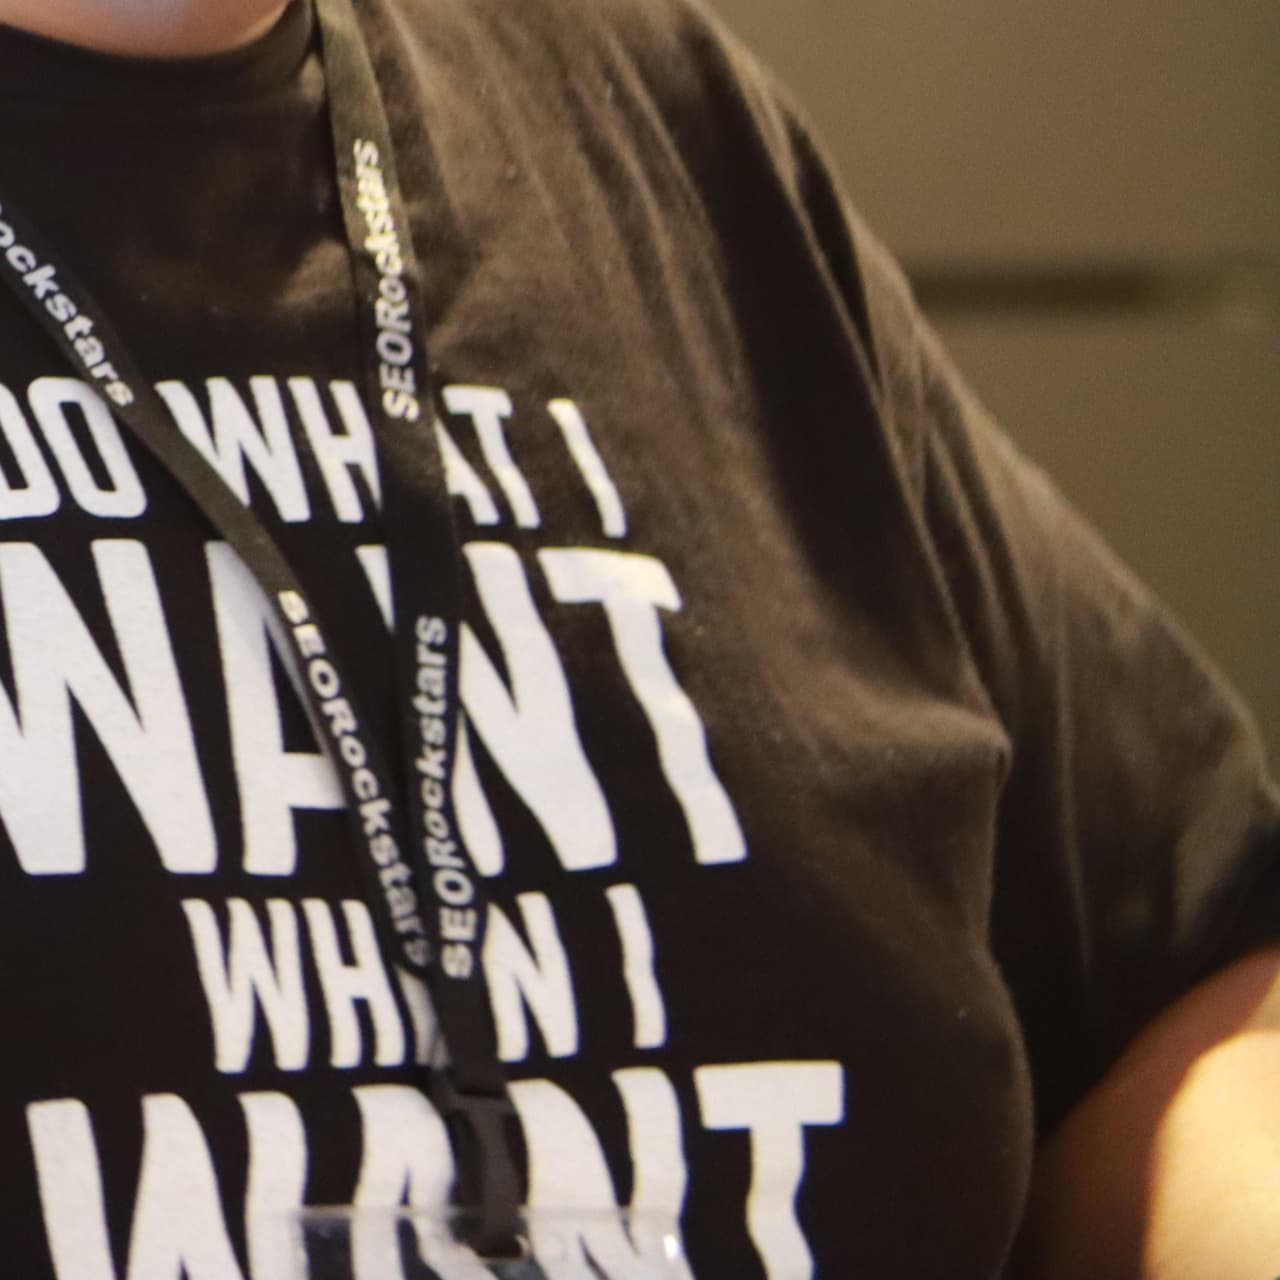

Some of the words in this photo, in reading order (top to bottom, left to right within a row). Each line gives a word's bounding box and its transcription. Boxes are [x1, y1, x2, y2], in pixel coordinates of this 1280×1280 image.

[352, 138, 420, 422] SEORockstars
[547, 397, 627, 538] I
[277, 588, 435, 968] SEORockstars
[412, 614, 478, 981] SEORockstars
[181, 891, 579, 1074] WHN
[604, 883, 668, 1050] I
